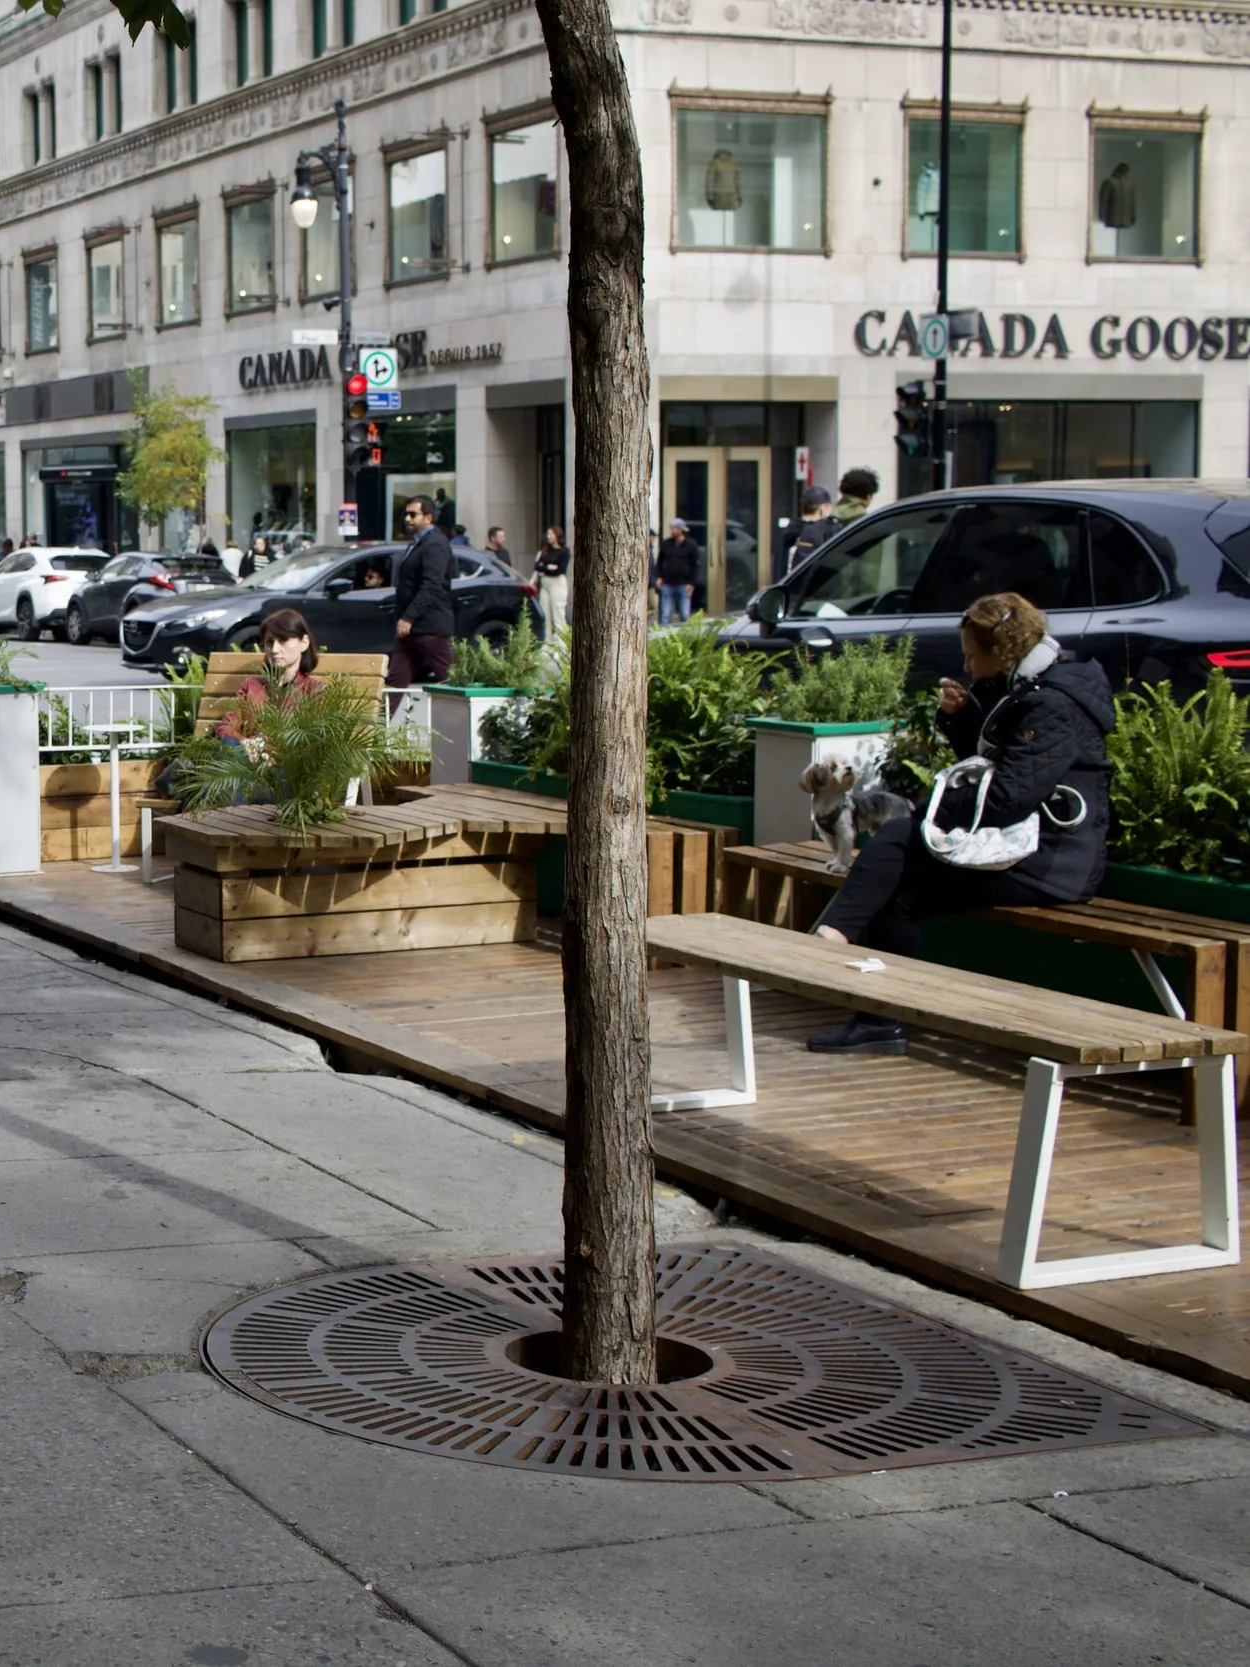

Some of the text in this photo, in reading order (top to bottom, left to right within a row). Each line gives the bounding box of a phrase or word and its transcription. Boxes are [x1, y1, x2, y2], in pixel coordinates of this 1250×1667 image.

[853, 309, 1250, 361] CAADA GOOSE
[238, 344, 333, 391] CANADA
